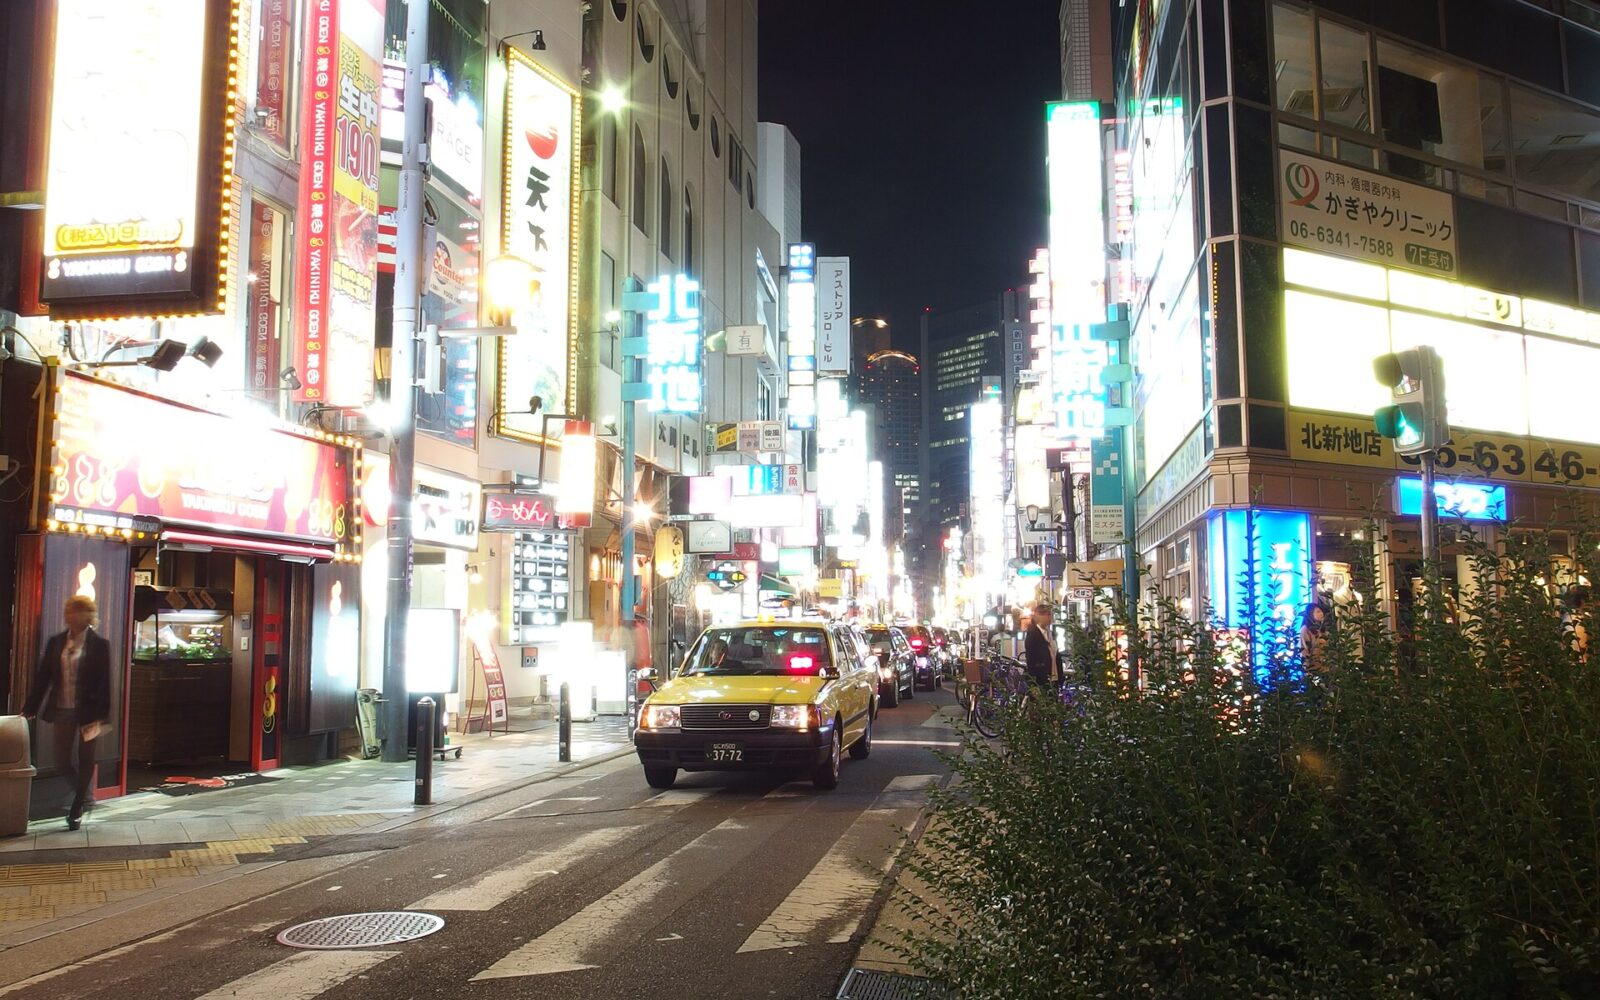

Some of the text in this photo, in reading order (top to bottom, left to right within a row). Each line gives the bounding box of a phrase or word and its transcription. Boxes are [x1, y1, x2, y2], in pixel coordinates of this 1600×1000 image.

[318, 14, 329, 44] GOEN
[339, 77, 380, 129] 生中
[311, 102, 327, 190] YAKINIKU GOEN
[1324, 170, 1402, 201] 内科・循環器内科
[1324, 191, 1452, 242] かぎやクリニック
[1290, 219, 1395, 258] 06-6341-7588
[1408, 246, 1451, 271] 7F受付
[306, 250, 322, 338] YAKINIKU GOEN
[647, 273, 700, 413] 北新地
[1301, 423, 1383, 457] 北新地店
[487, 498, 549, 522] らーめん
[713, 749, 742, 761] 37-72
